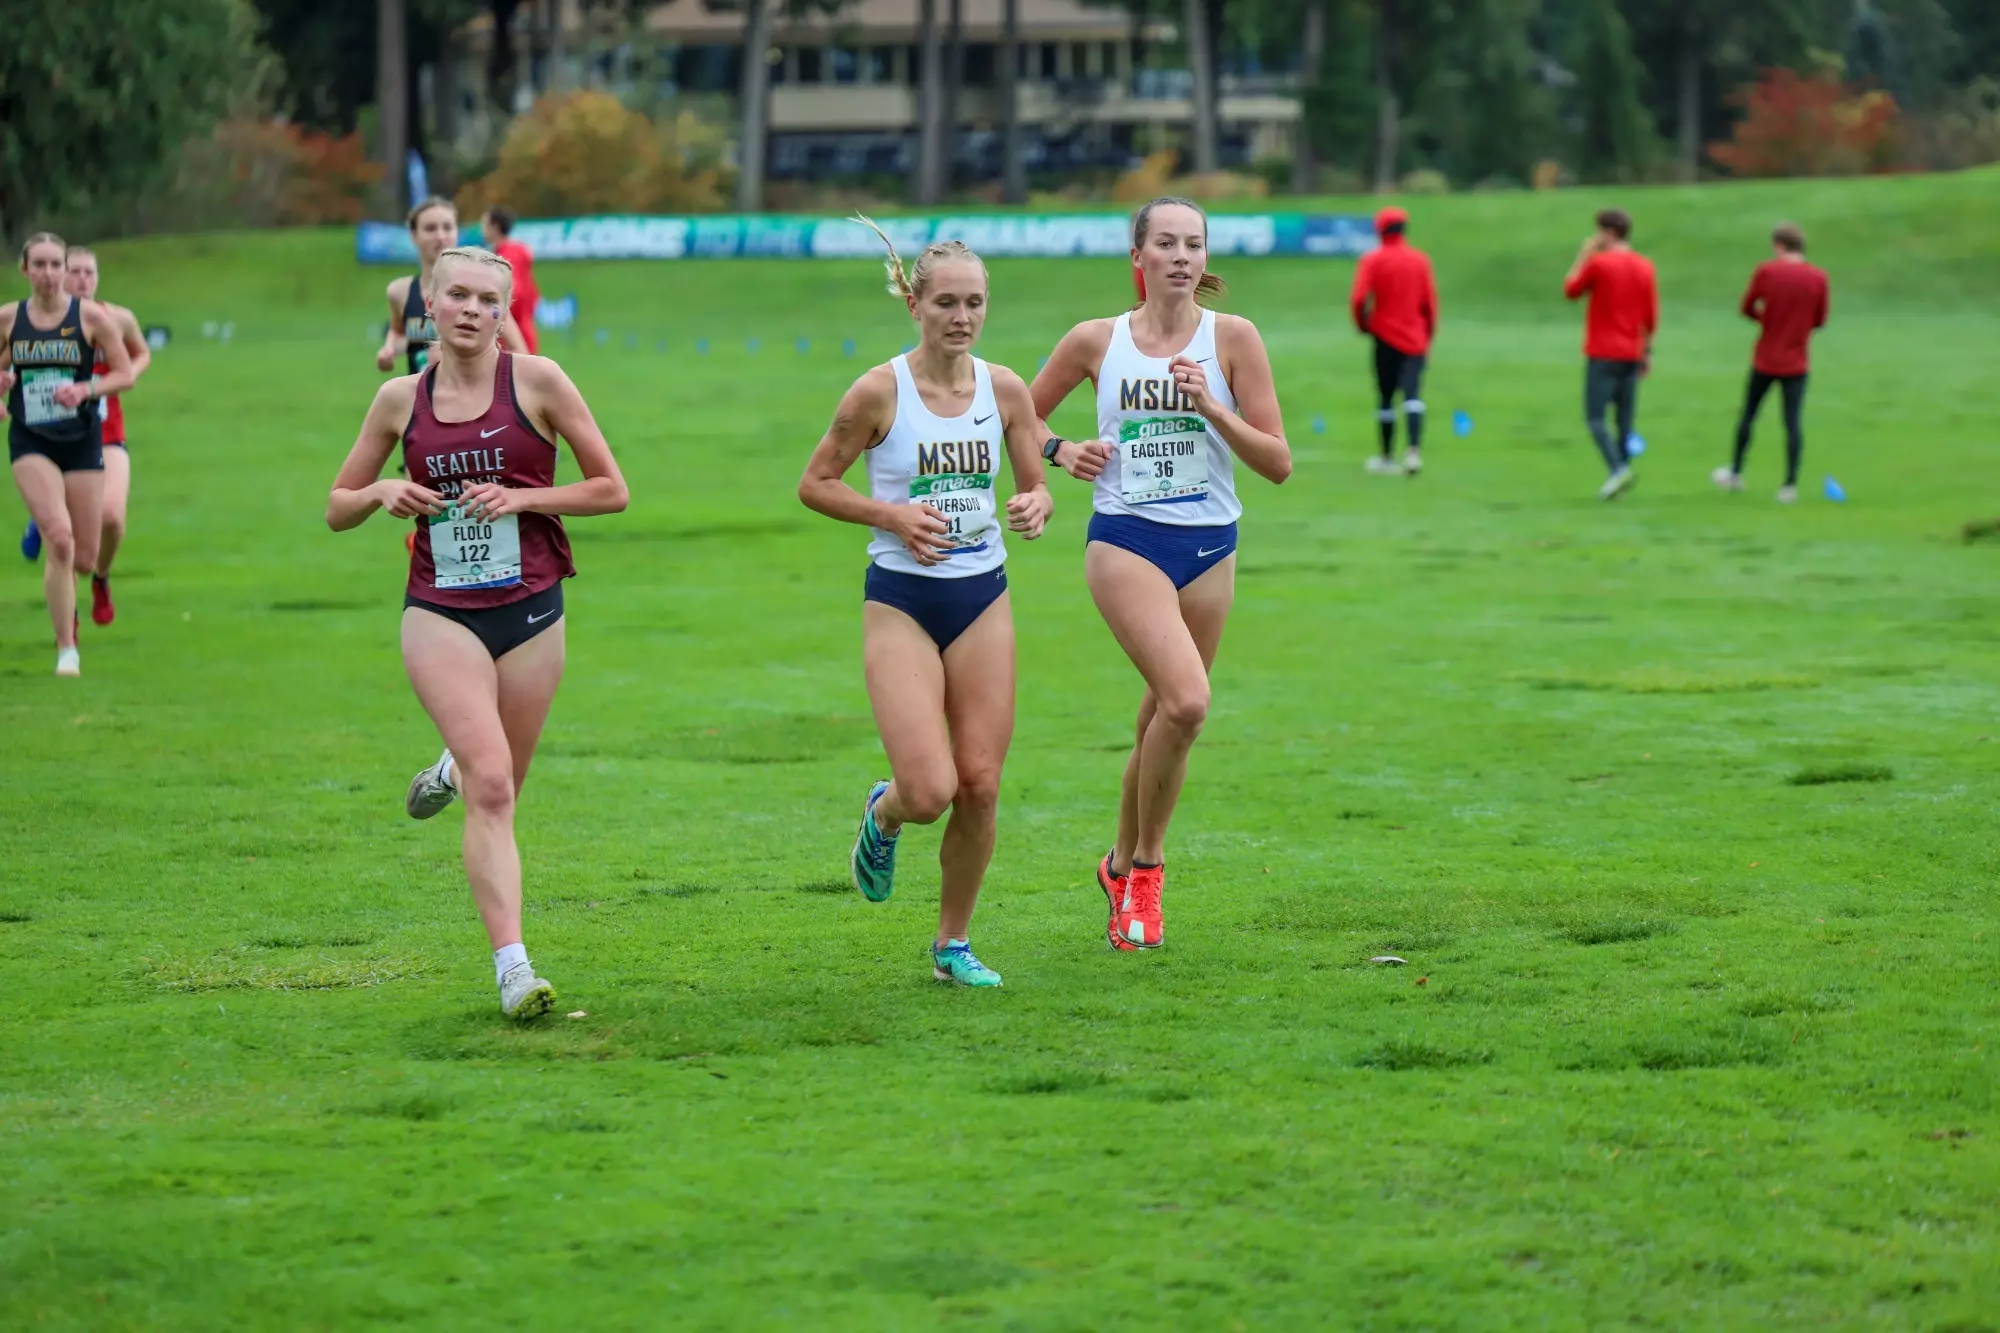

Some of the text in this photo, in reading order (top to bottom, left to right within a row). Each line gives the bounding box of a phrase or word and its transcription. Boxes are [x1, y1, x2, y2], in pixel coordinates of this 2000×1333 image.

[513, 219, 689, 258] ELCOME
[13, 340, 81, 365] ALASKA
[1138, 420, 1187, 440] gnac
[918, 440, 991, 476] MSUB
[1131, 440, 1195, 458] EAGLETON
[425, 447, 505, 478] SEATTLE
[1154, 461, 1174, 478] 36
[930, 475, 976, 497] gnac
[453, 524, 492, 541] FLOLO
[460, 544, 490, 562] 122
